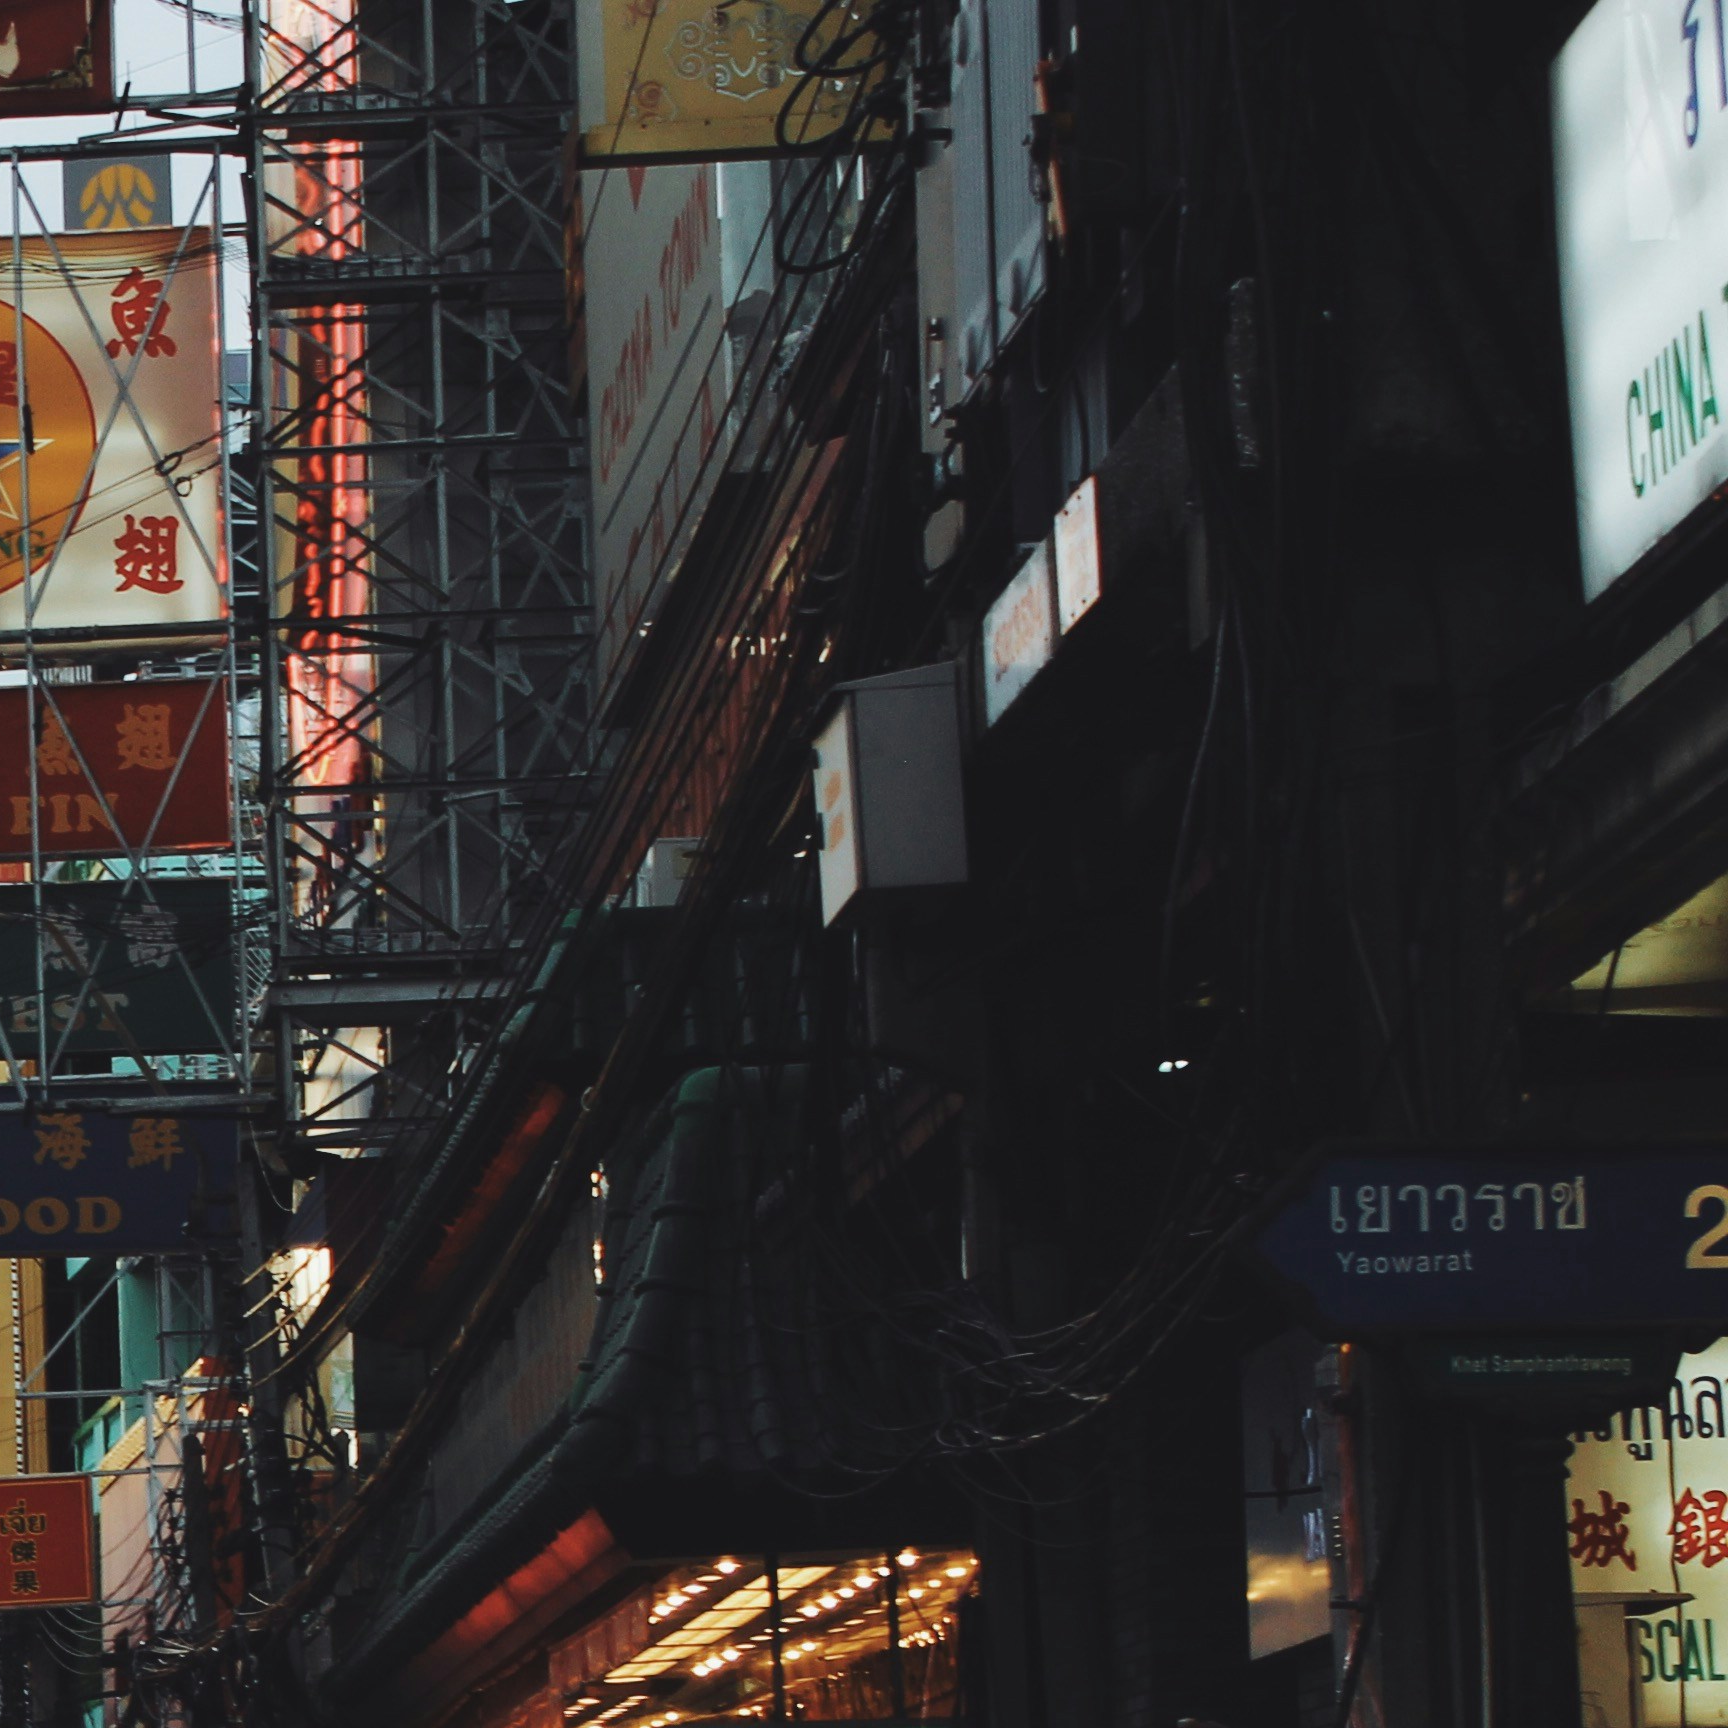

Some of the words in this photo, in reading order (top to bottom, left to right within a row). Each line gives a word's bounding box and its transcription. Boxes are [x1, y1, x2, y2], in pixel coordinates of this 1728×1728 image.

[105, 266, 185, 595] 魚翅
[1626, 309, 1718, 498] CHINA
[1329, 1176, 1587, 1234] เยาวราช
[1336, 1250, 1474, 1275] Yaowarat
[1640, 1618, 1728, 1683] SCAL
